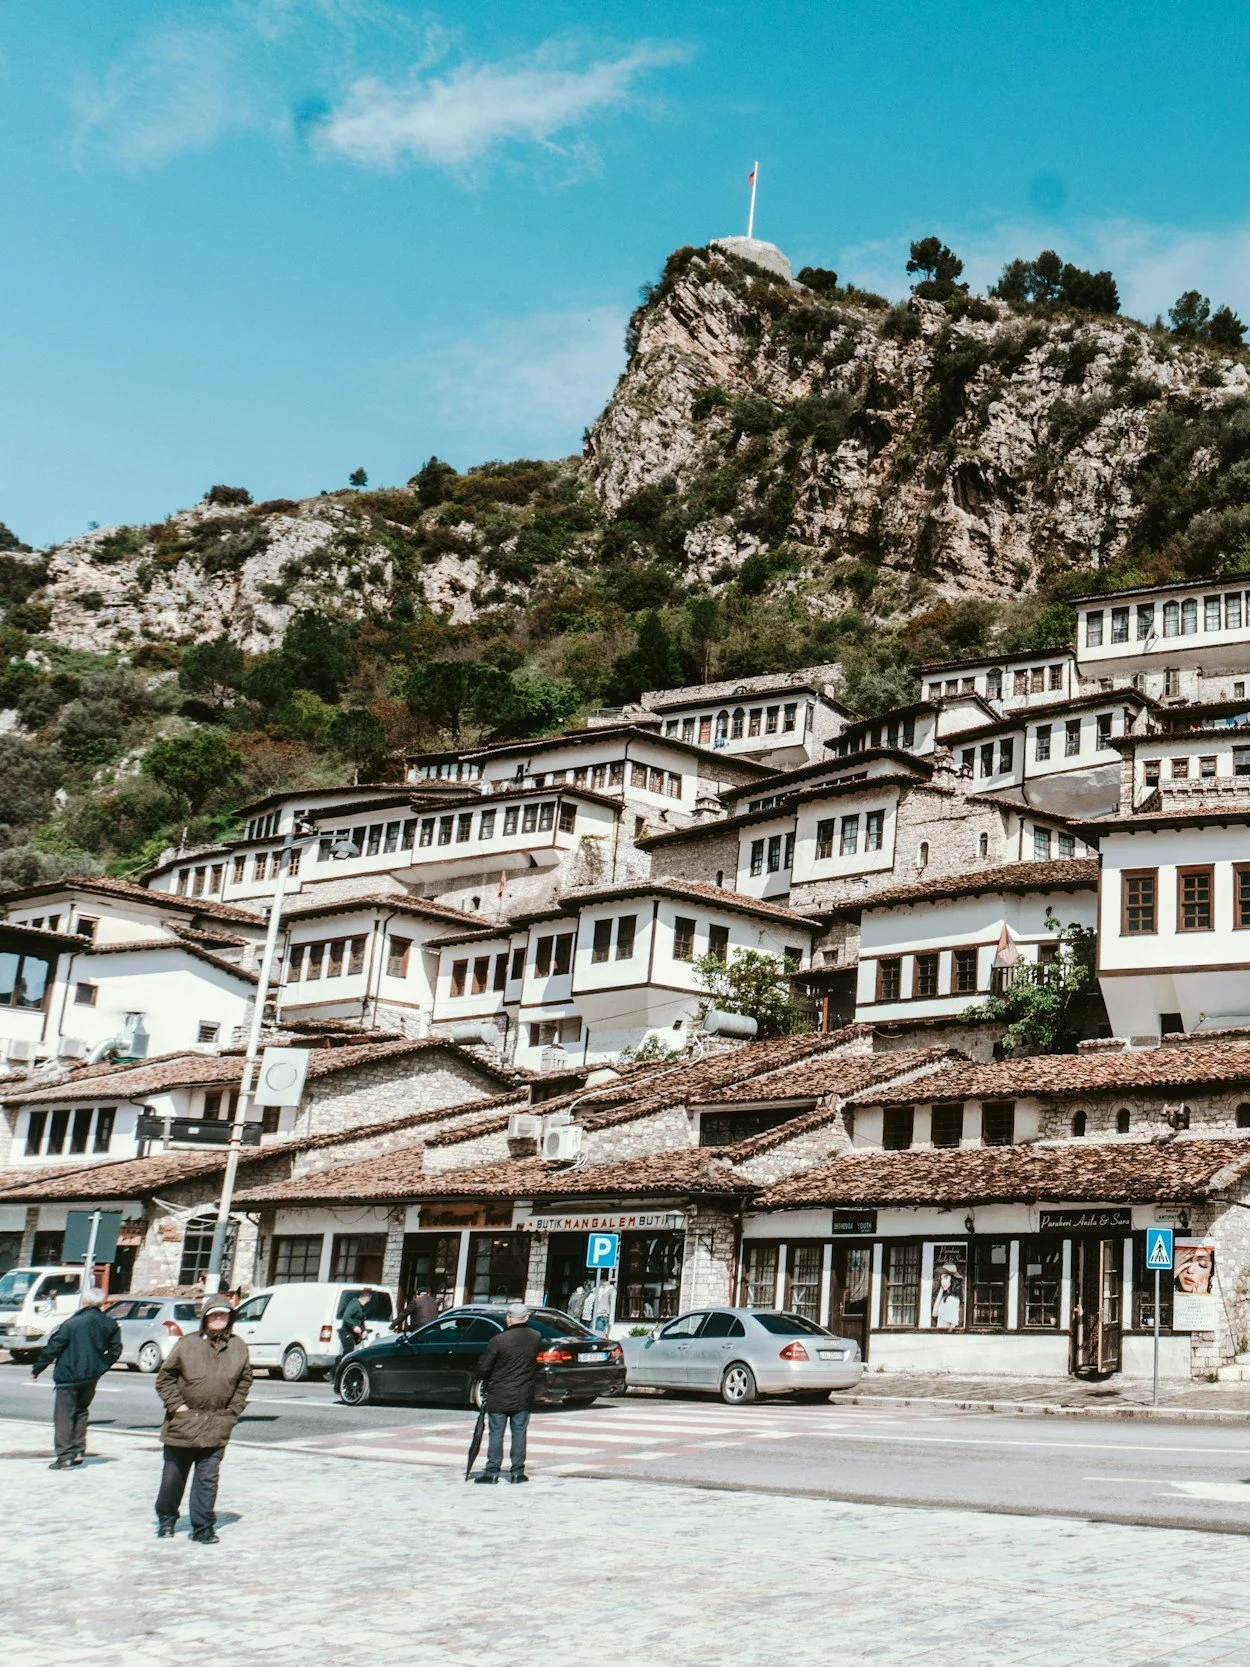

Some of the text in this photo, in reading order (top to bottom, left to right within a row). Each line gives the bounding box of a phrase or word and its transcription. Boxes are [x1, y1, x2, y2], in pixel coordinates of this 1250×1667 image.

[536, 1219, 562, 1229] BUTIK
[564, 1217, 635, 1229] MANGALEM
[1073, 1213, 1097, 1227] Anila
[1100, 1213, 1110, 1226] &
[1110, 1212, 1130, 1226] Sara
[592, 1237, 612, 1265] P
